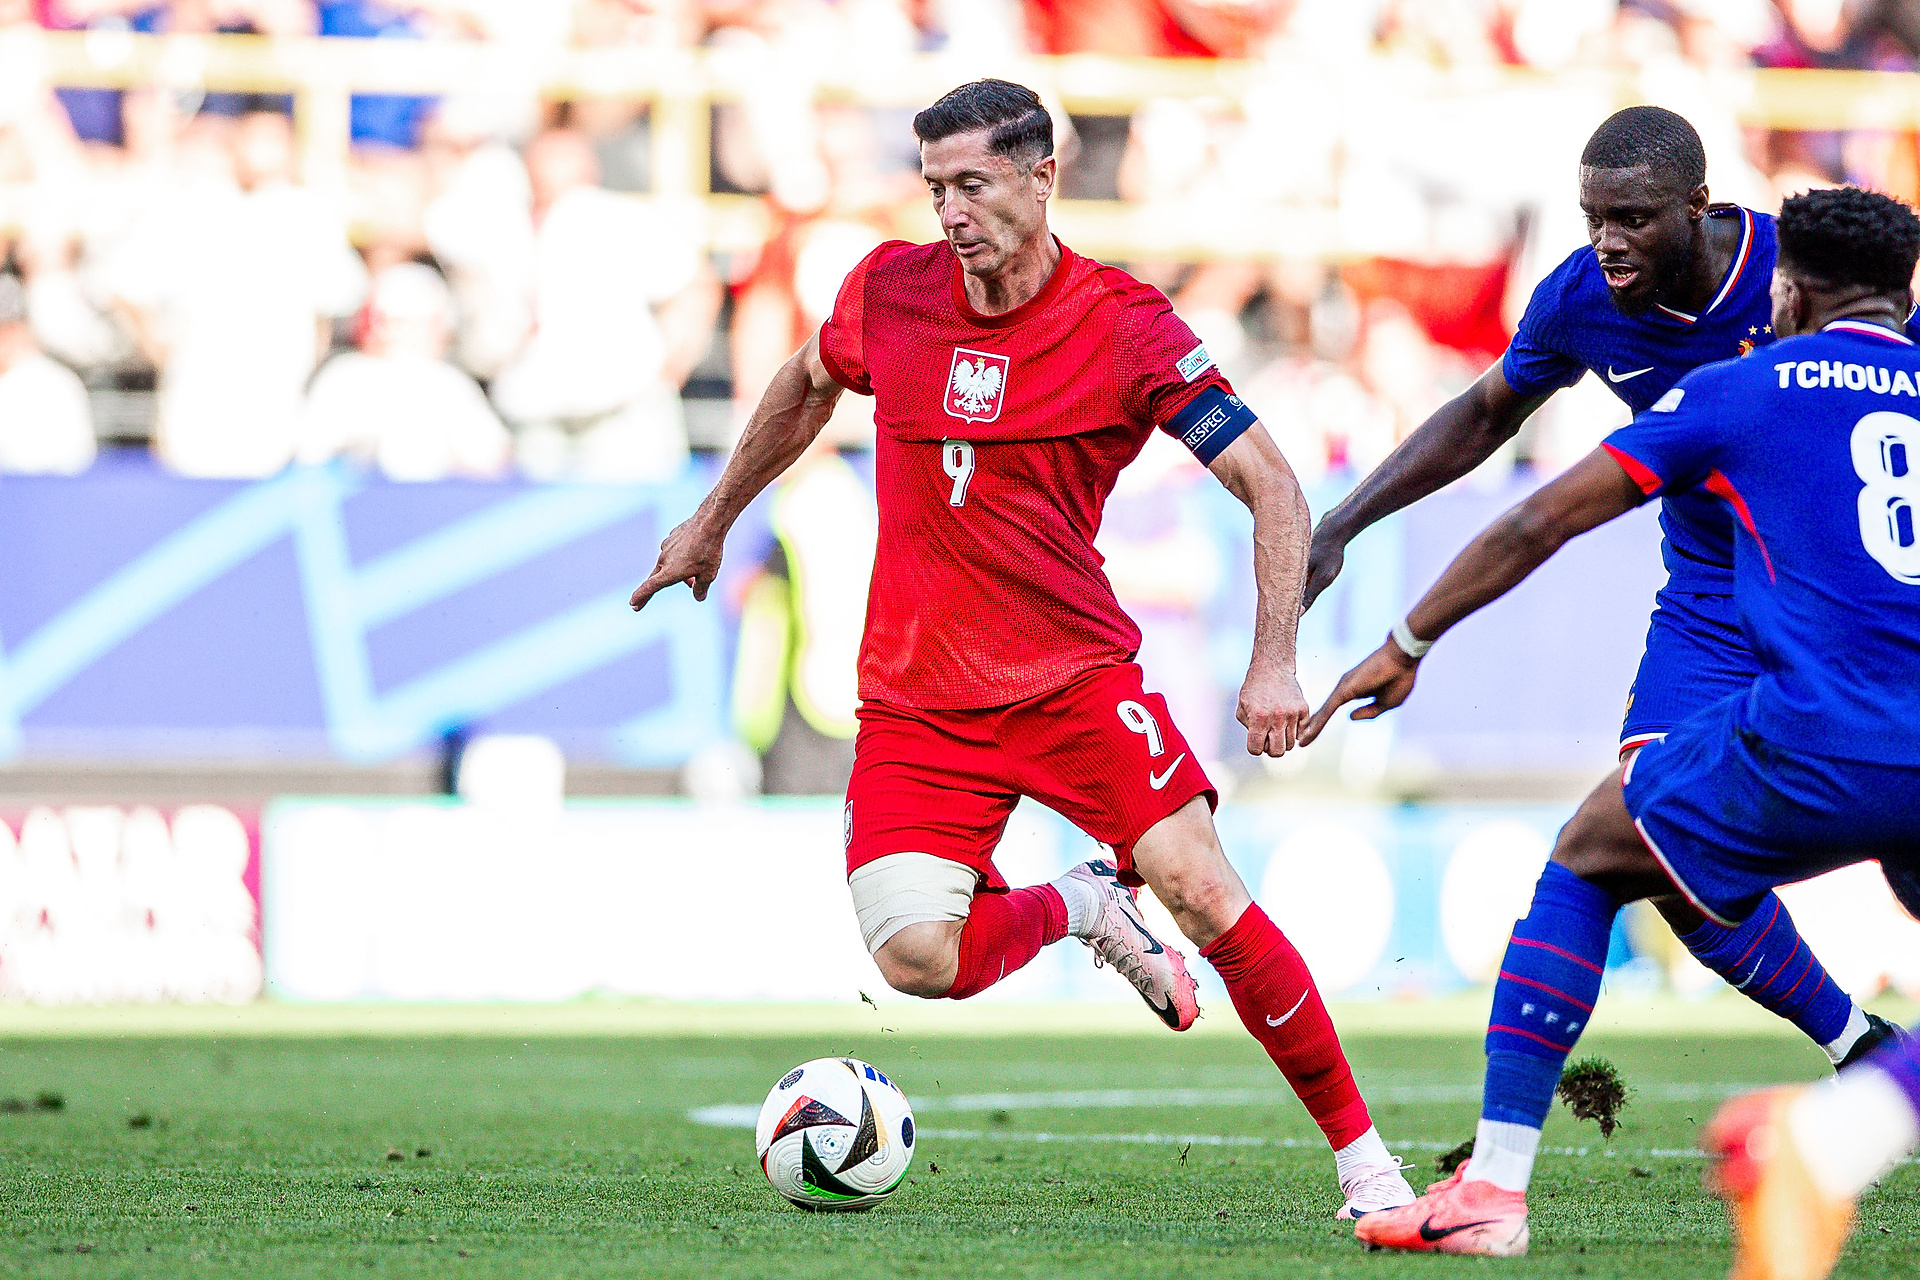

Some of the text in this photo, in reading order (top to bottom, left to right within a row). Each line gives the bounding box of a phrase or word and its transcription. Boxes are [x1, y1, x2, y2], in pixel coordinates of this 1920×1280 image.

[1773, 360, 1920, 397] TCHOUA
[1185, 408, 1226, 448] RESPECT
[942, 438, 976, 507] 9
[1850, 411, 1920, 586] 8
[1116, 700, 1165, 757] 9
